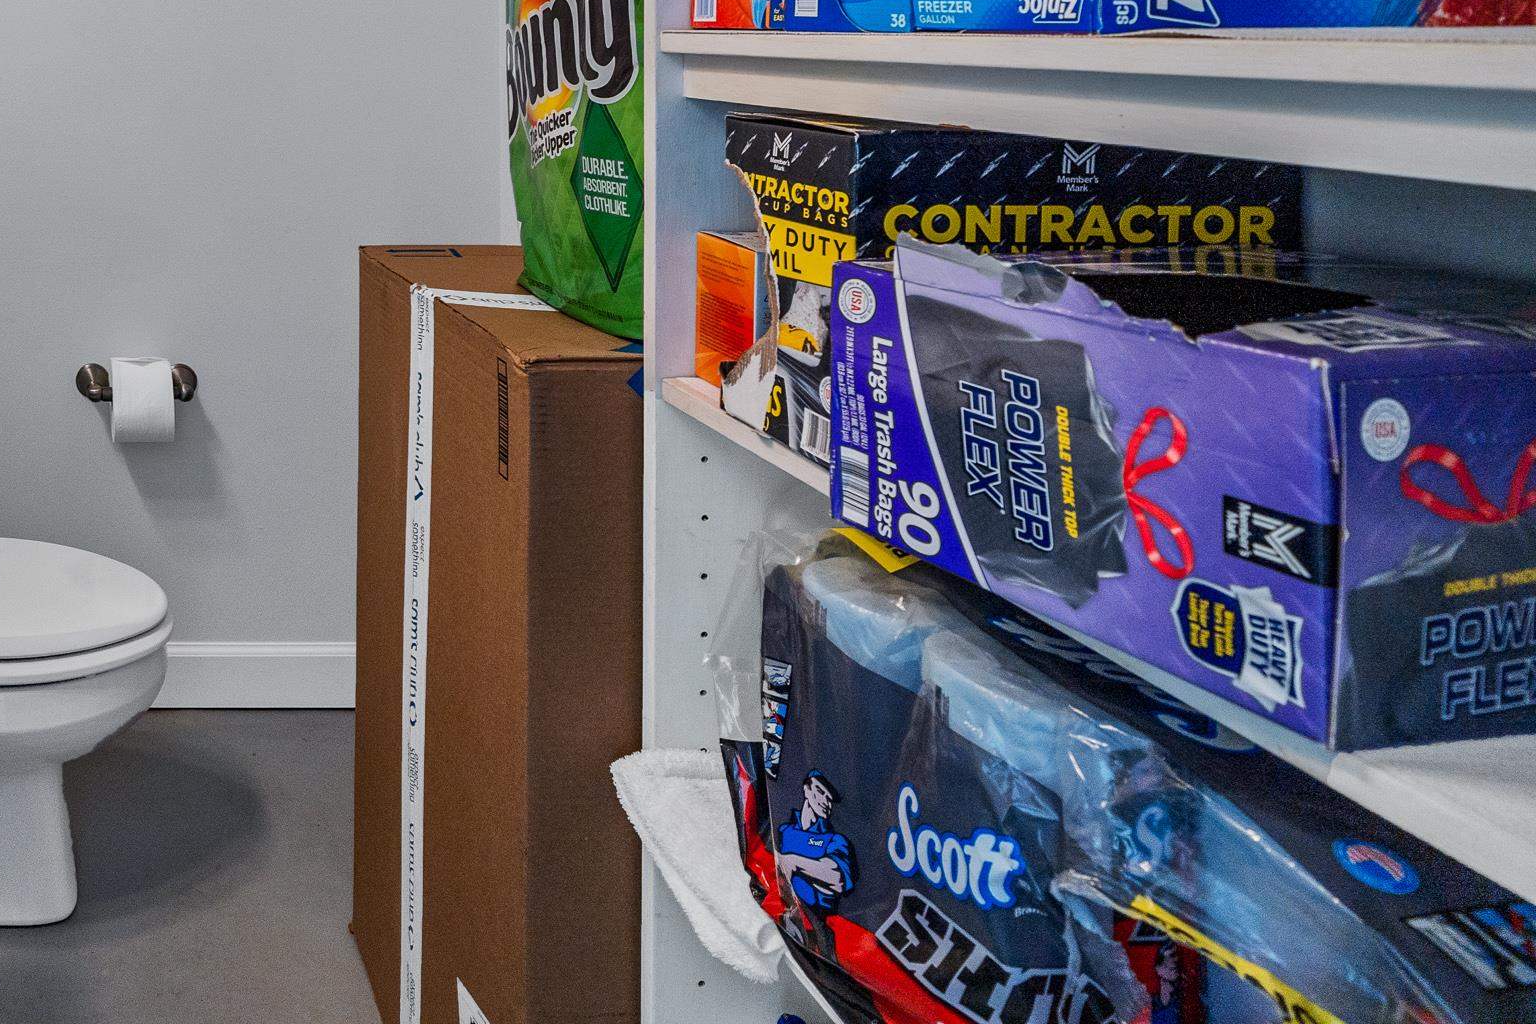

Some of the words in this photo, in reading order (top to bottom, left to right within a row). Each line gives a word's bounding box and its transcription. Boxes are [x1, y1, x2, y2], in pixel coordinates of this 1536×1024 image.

[890, 14, 906, 27] 38
[918, 0, 972, 13] FREEZER
[919, 14, 955, 24] GALLON
[536, 111, 572, 142] Quicker
[545, 130, 576, 156] Upper
[582, 156, 629, 180] DURABLE.
[770, 157, 791, 167] Member's
[774, 164, 785, 172] Mark
[583, 177, 628, 198] ABSORBENT.
[1057, 175, 1099, 184] Member's
[1066, 184, 1088, 192] Mark
[584, 194, 631, 218] CLOTHLIKE.
[803, 208, 848, 227] BAGS
[883, 204, 1275, 245] CONTRACTOR
[786, 228, 847, 260] DUTY
[851, 290, 862, 311] USA
[868, 336, 893, 404] Large
[874, 411, 897, 476] Trash
[959, 380, 1004, 508] FLEX
[1056, 406, 1072, 462] DOUBLE
[1374, 422, 1396, 438] USA
[1001, 369, 1053, 551] POWER
[1061, 466, 1075, 507] THICK
[874, 478, 897, 539] Bags
[899, 482, 941, 556] 90
[1064, 509, 1079, 539] TOP
[1249, 614, 1269, 677] DUTY
[1420, 597, 1536, 666] POW
[1269, 618, 1287, 687] HEAVY
[1441, 655, 1536, 720] FLE
[887, 786, 1020, 907] Scott
